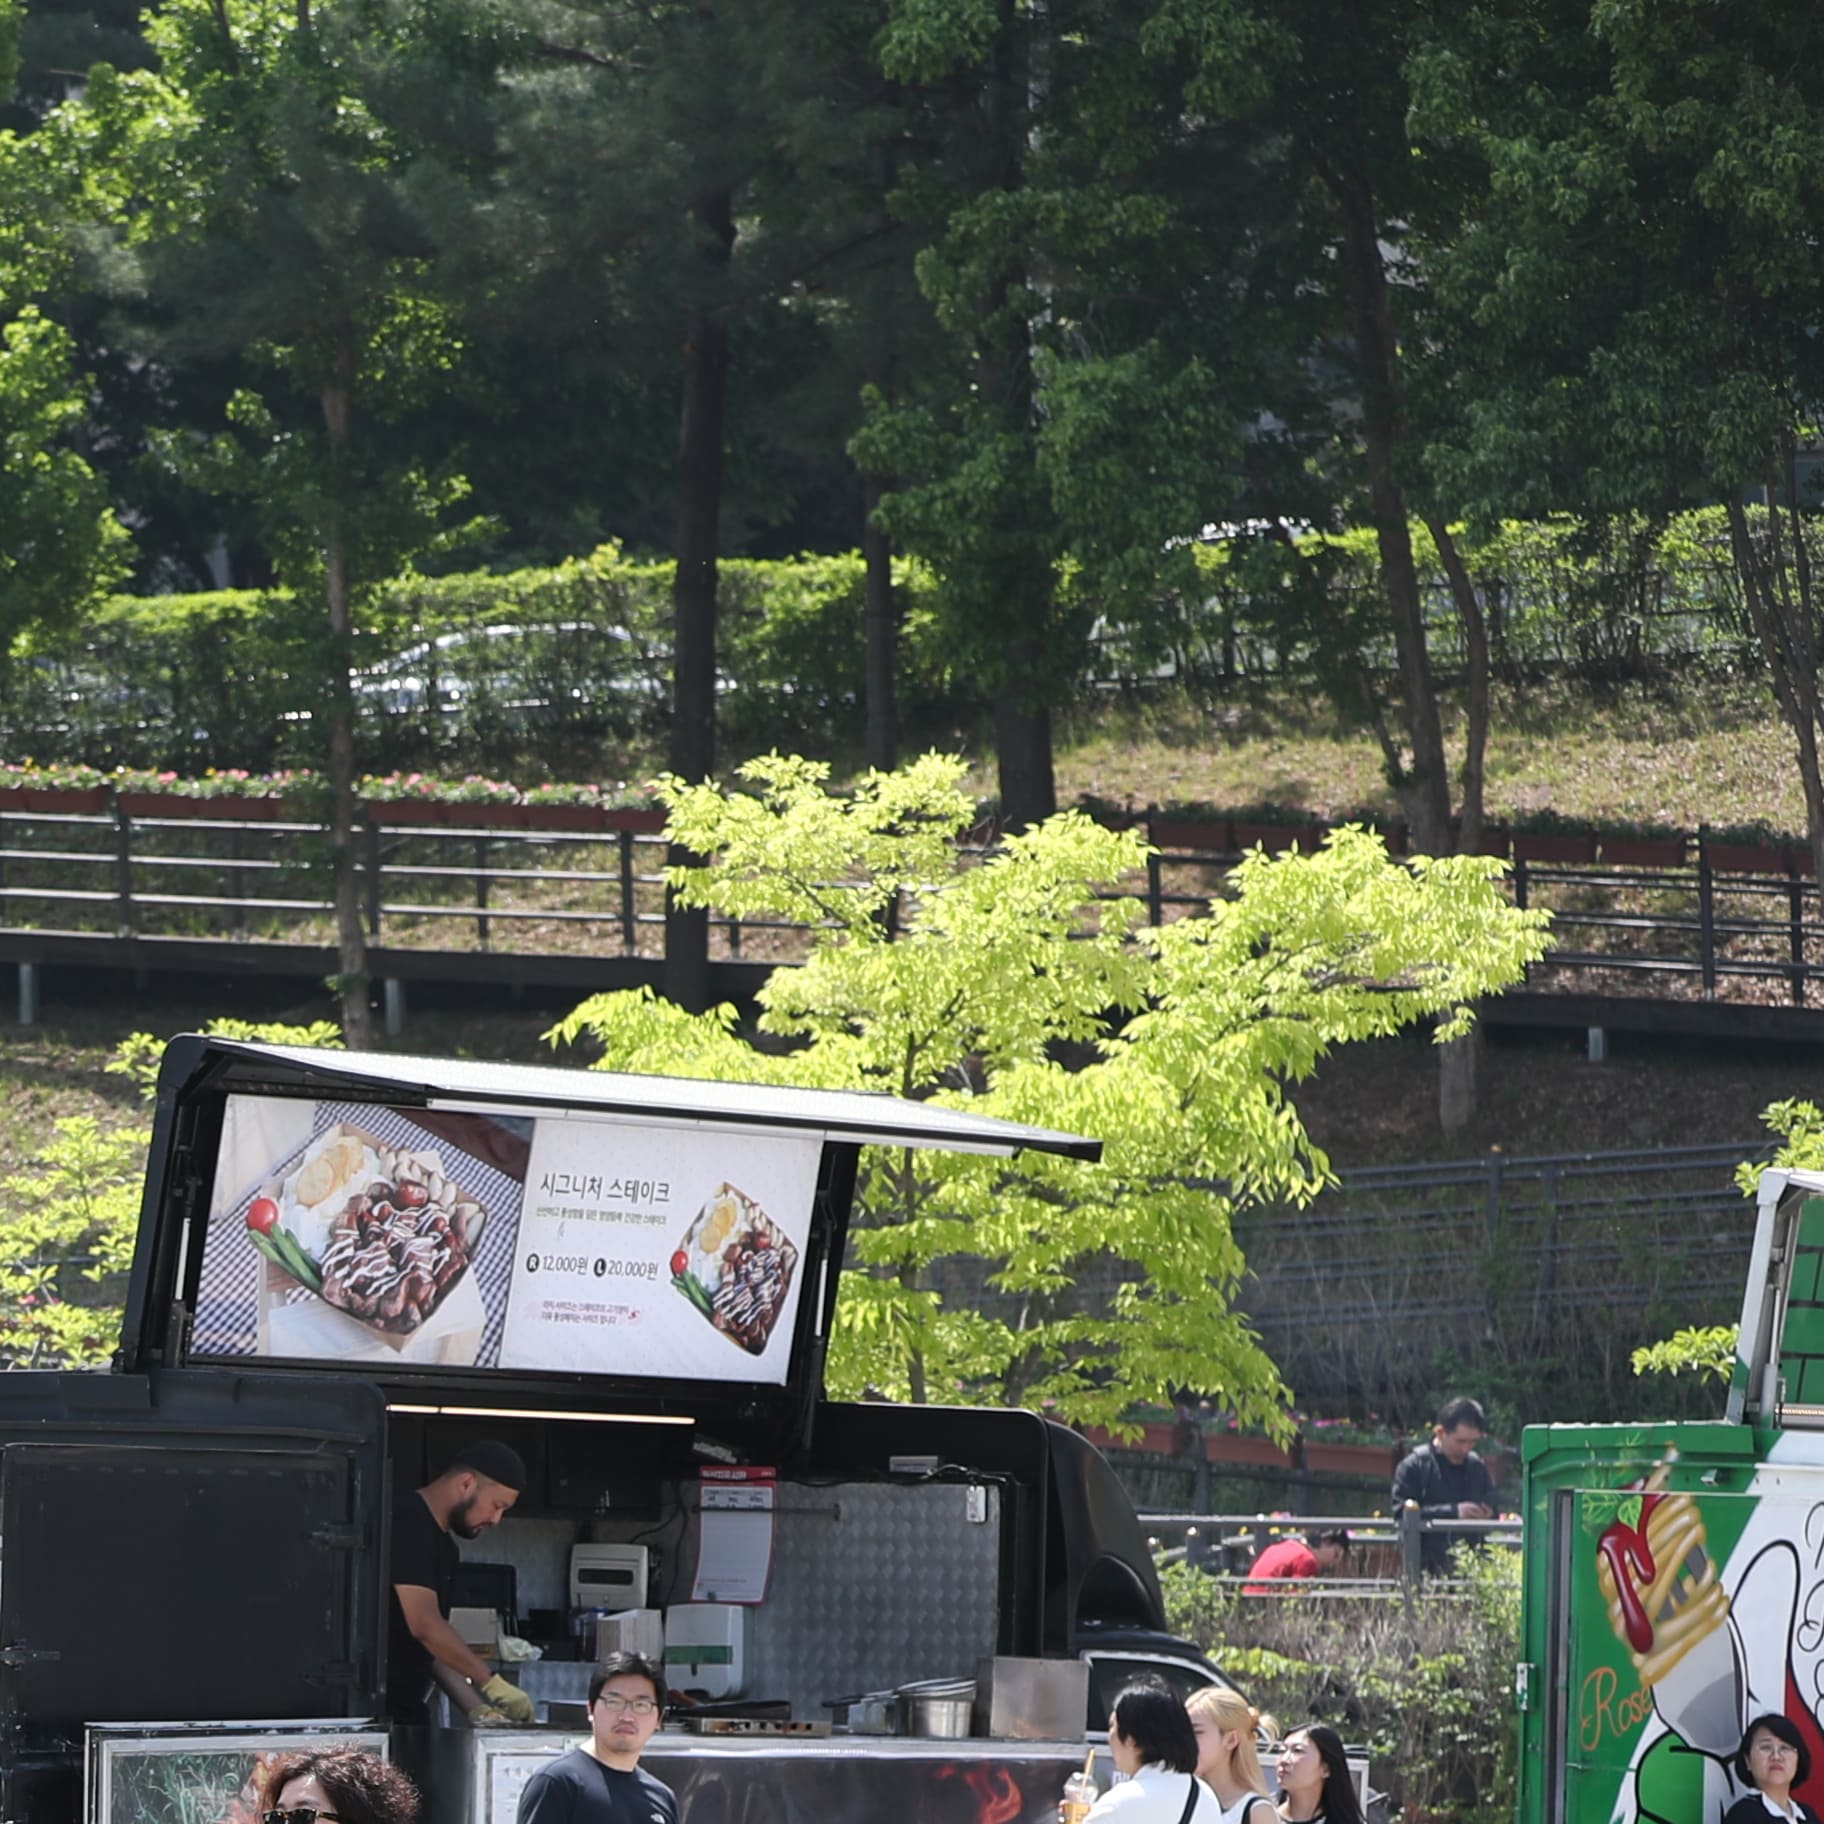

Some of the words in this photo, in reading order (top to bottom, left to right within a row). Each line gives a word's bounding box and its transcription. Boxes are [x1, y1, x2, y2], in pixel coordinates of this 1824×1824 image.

[540, 1172, 603, 1201] 시그니처
[607, 1178, 671, 1206] 스테이크
[543, 1255, 588, 1276] 12,000원
[608, 1259, 659, 1281] 20,000원
